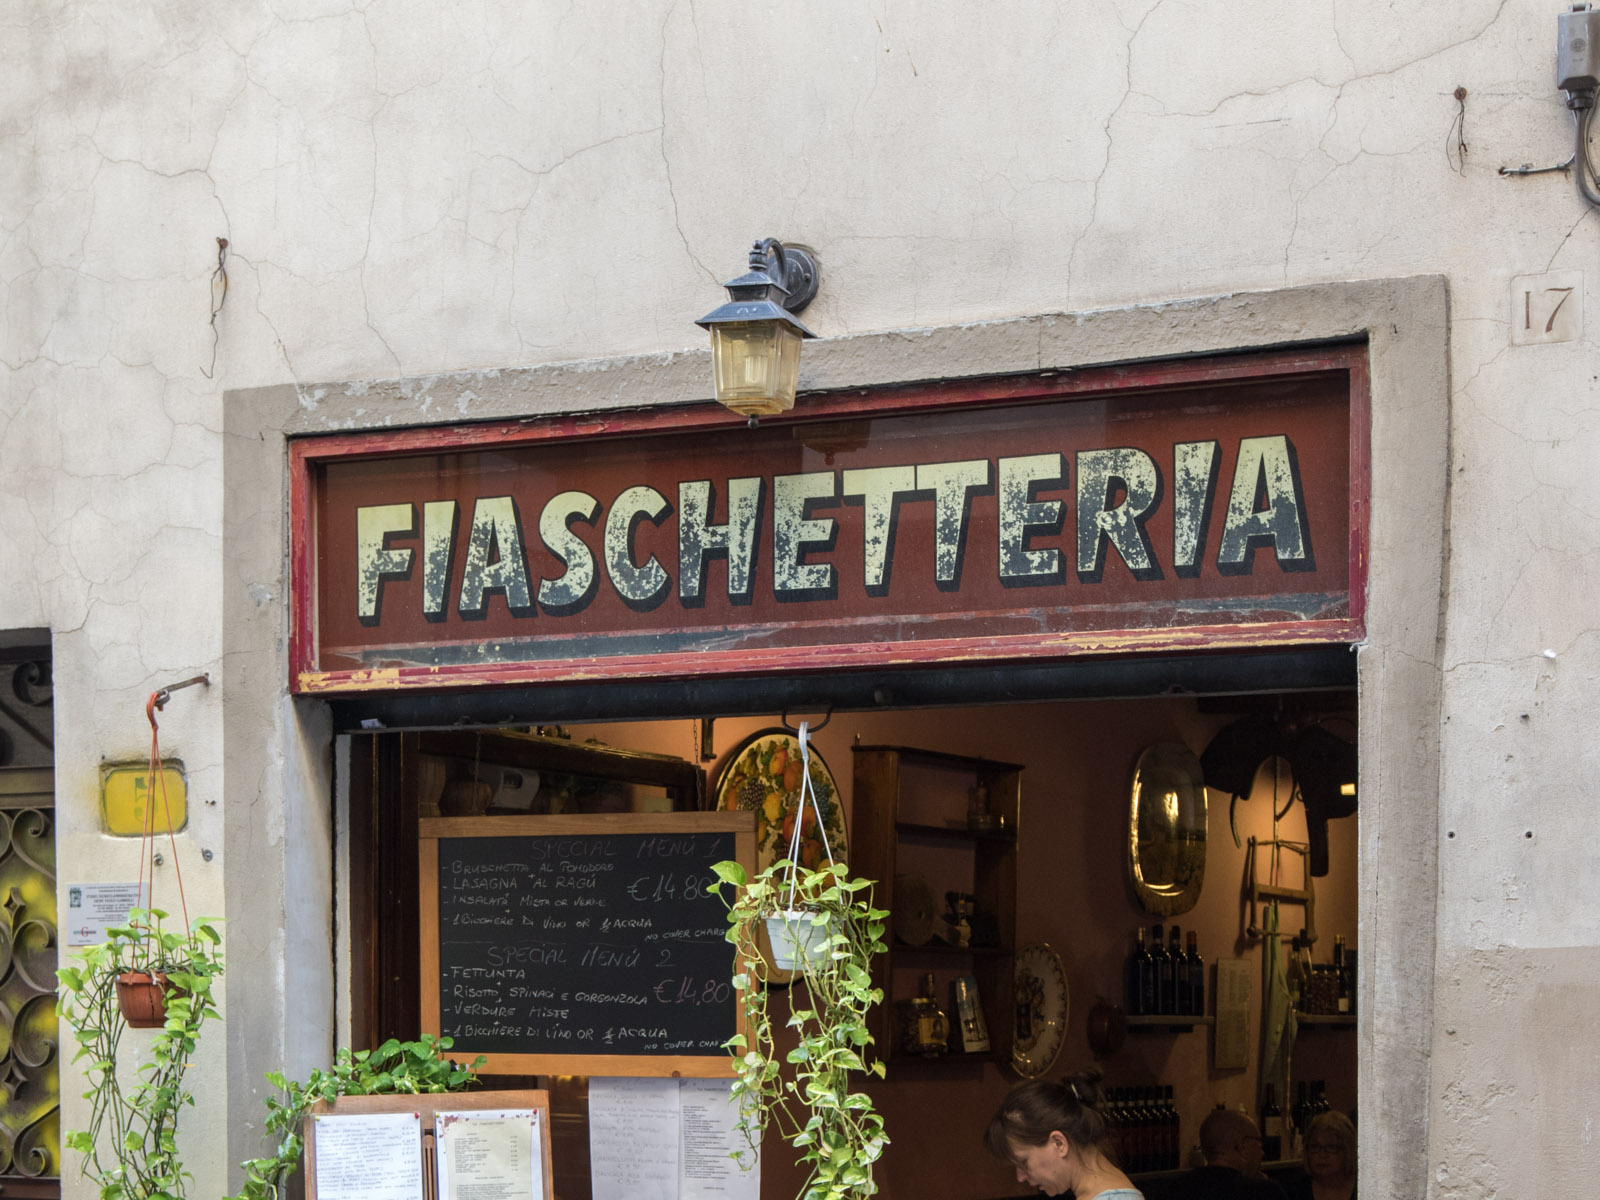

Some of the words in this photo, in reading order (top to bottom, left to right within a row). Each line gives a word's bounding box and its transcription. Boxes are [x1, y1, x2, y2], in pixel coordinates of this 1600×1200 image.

[1523, 286, 1575, 334] 17
[356, 434, 1316, 626] FIASCHETTERIA
[134, 776, 160, 823] 5
[528, 838, 617, 861] SPECIAL
[703, 838, 721, 857] 1
[452, 859, 529, 874] BRUSCHETTA
[539, 863, 553, 872] AL
[559, 861, 614, 873] POMODORO
[453, 877, 517, 890] LASAGNA
[533, 878, 547, 888] AL
[554, 898, 568, 906] OR
[575, 917, 591, 928] OR
[613, 918, 652, 929] ACQUA
[662, 929, 691, 939] COVER
[694, 927, 728, 937] CHARG
[487, 943, 568, 967] SPECIAL
[655, 949, 677, 968] 2
[450, 966, 526, 979] FETTUNTA
[453, 984, 499, 998] RISOTTO
[509, 986, 554, 998] SPINACI
[560, 992, 568, 1000] E
[575, 991, 648, 1004] GORGONZOLA
[454, 1001, 516, 1017] VERDURE
[464, 1024, 522, 1037] BICCHIERE
[526, 1027, 540, 1037] DI
[576, 1028, 594, 1040] OR
[618, 1027, 668, 1039] ACQUA
